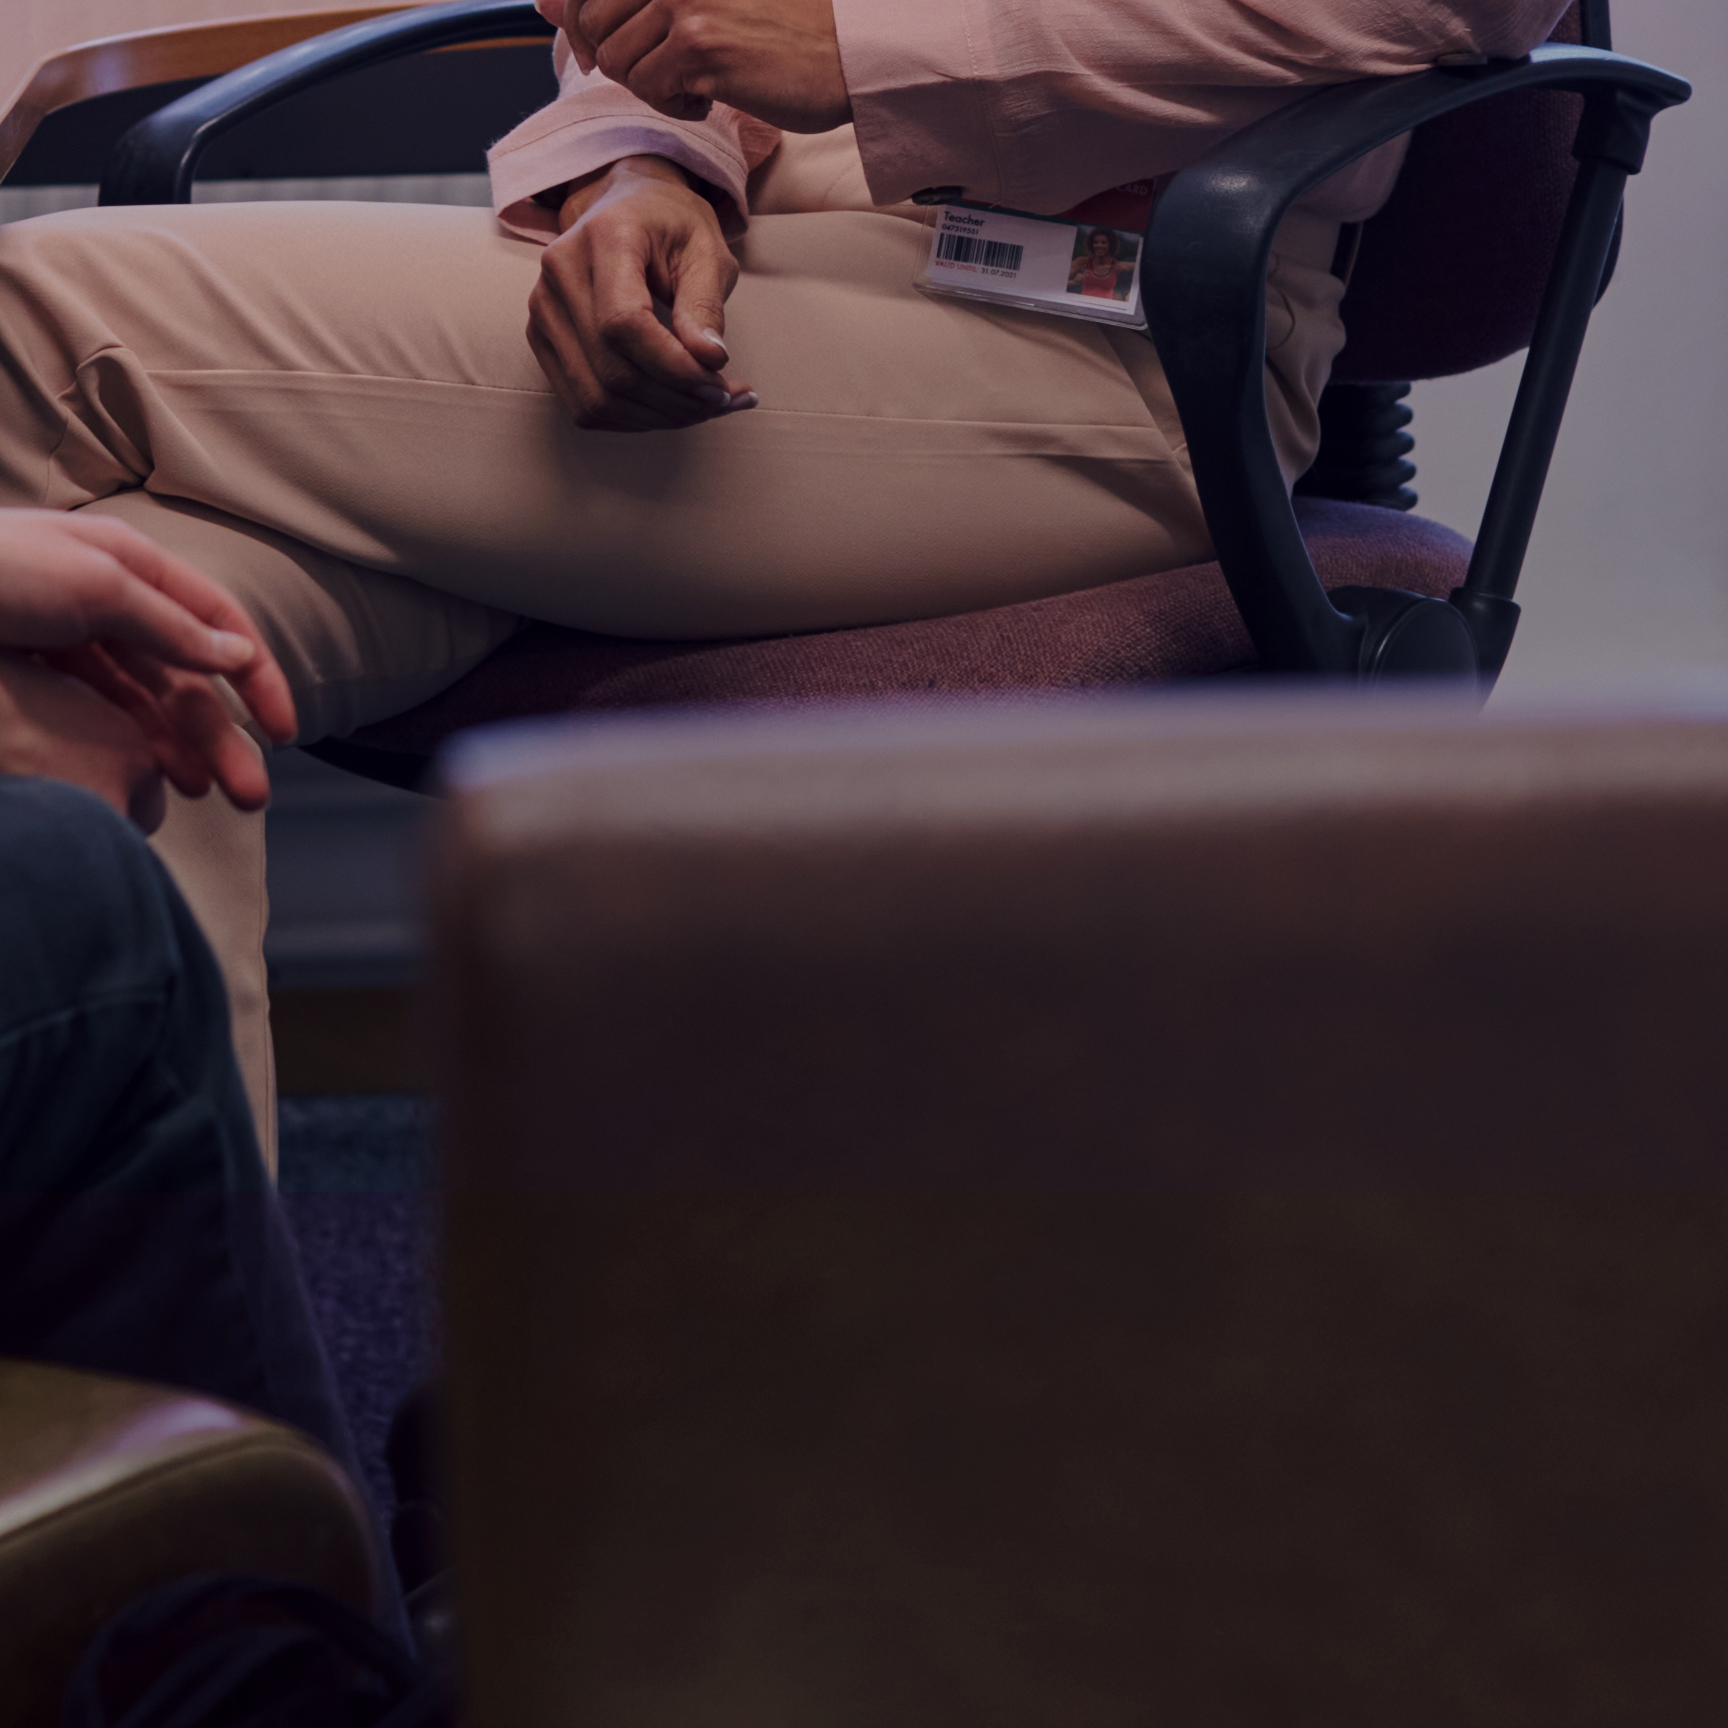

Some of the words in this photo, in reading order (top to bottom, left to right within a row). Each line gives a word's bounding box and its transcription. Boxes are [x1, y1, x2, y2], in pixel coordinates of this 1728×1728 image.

[944, 210, 986, 226] Teacher
[935, 260, 955, 269] VALID
[981, 267, 1016, 279] 31.07.2021
